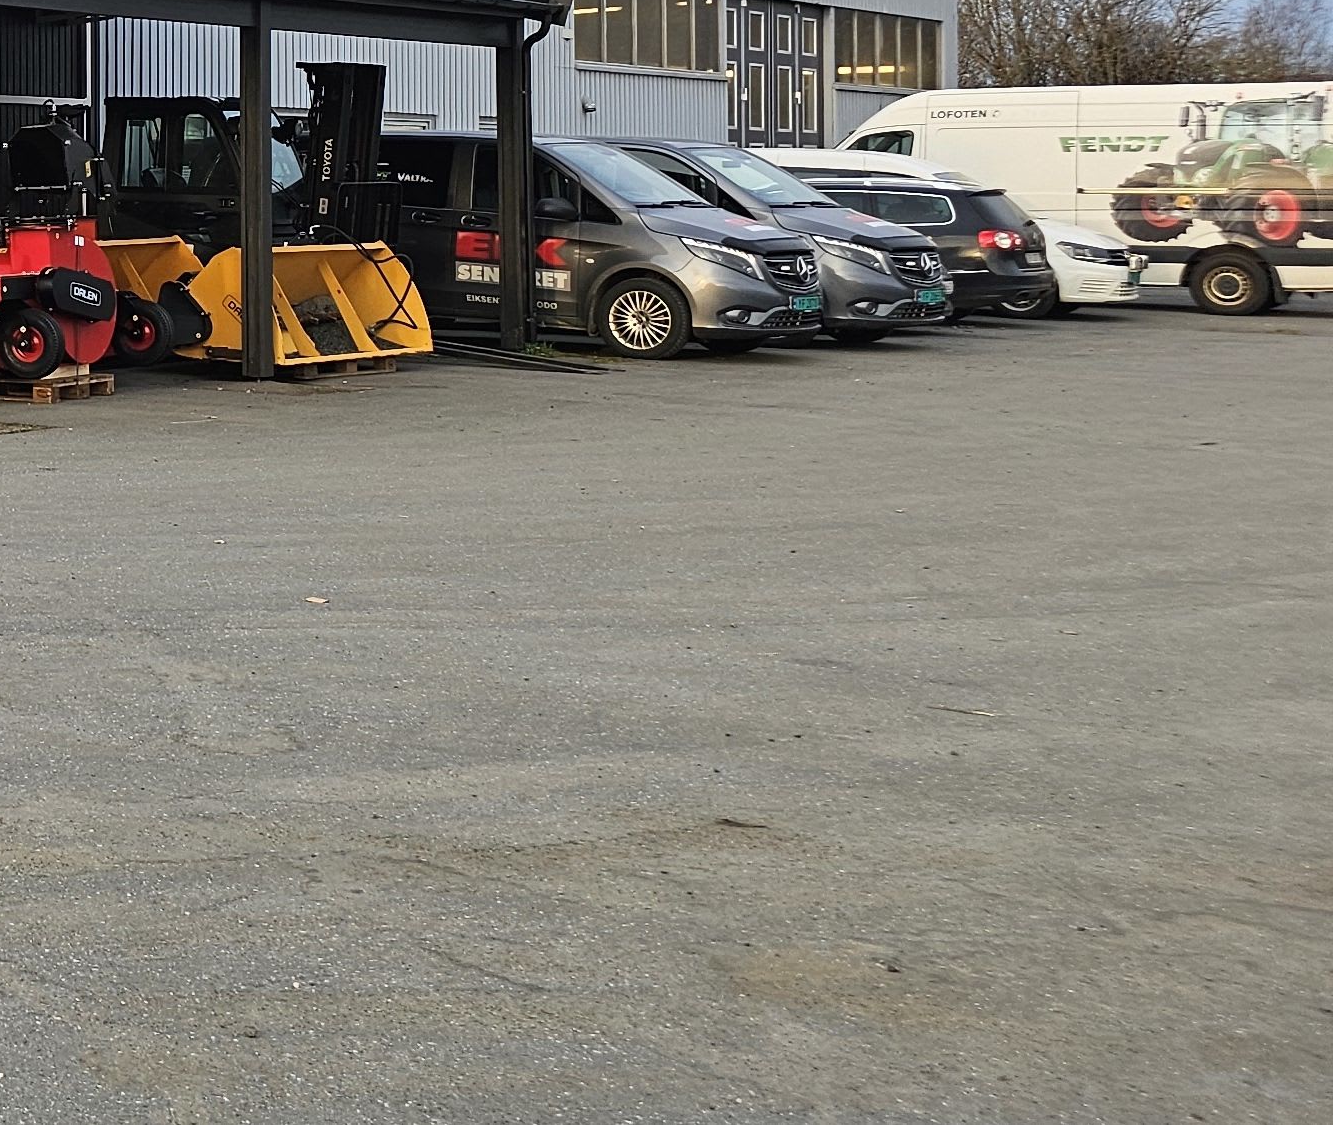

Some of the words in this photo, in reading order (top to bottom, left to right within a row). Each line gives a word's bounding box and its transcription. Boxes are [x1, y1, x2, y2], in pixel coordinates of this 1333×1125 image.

[930, 110, 986, 119] LOFOTEN
[1058, 136, 1169, 153] FENDT
[321, 138, 334, 182] TOYOTA
